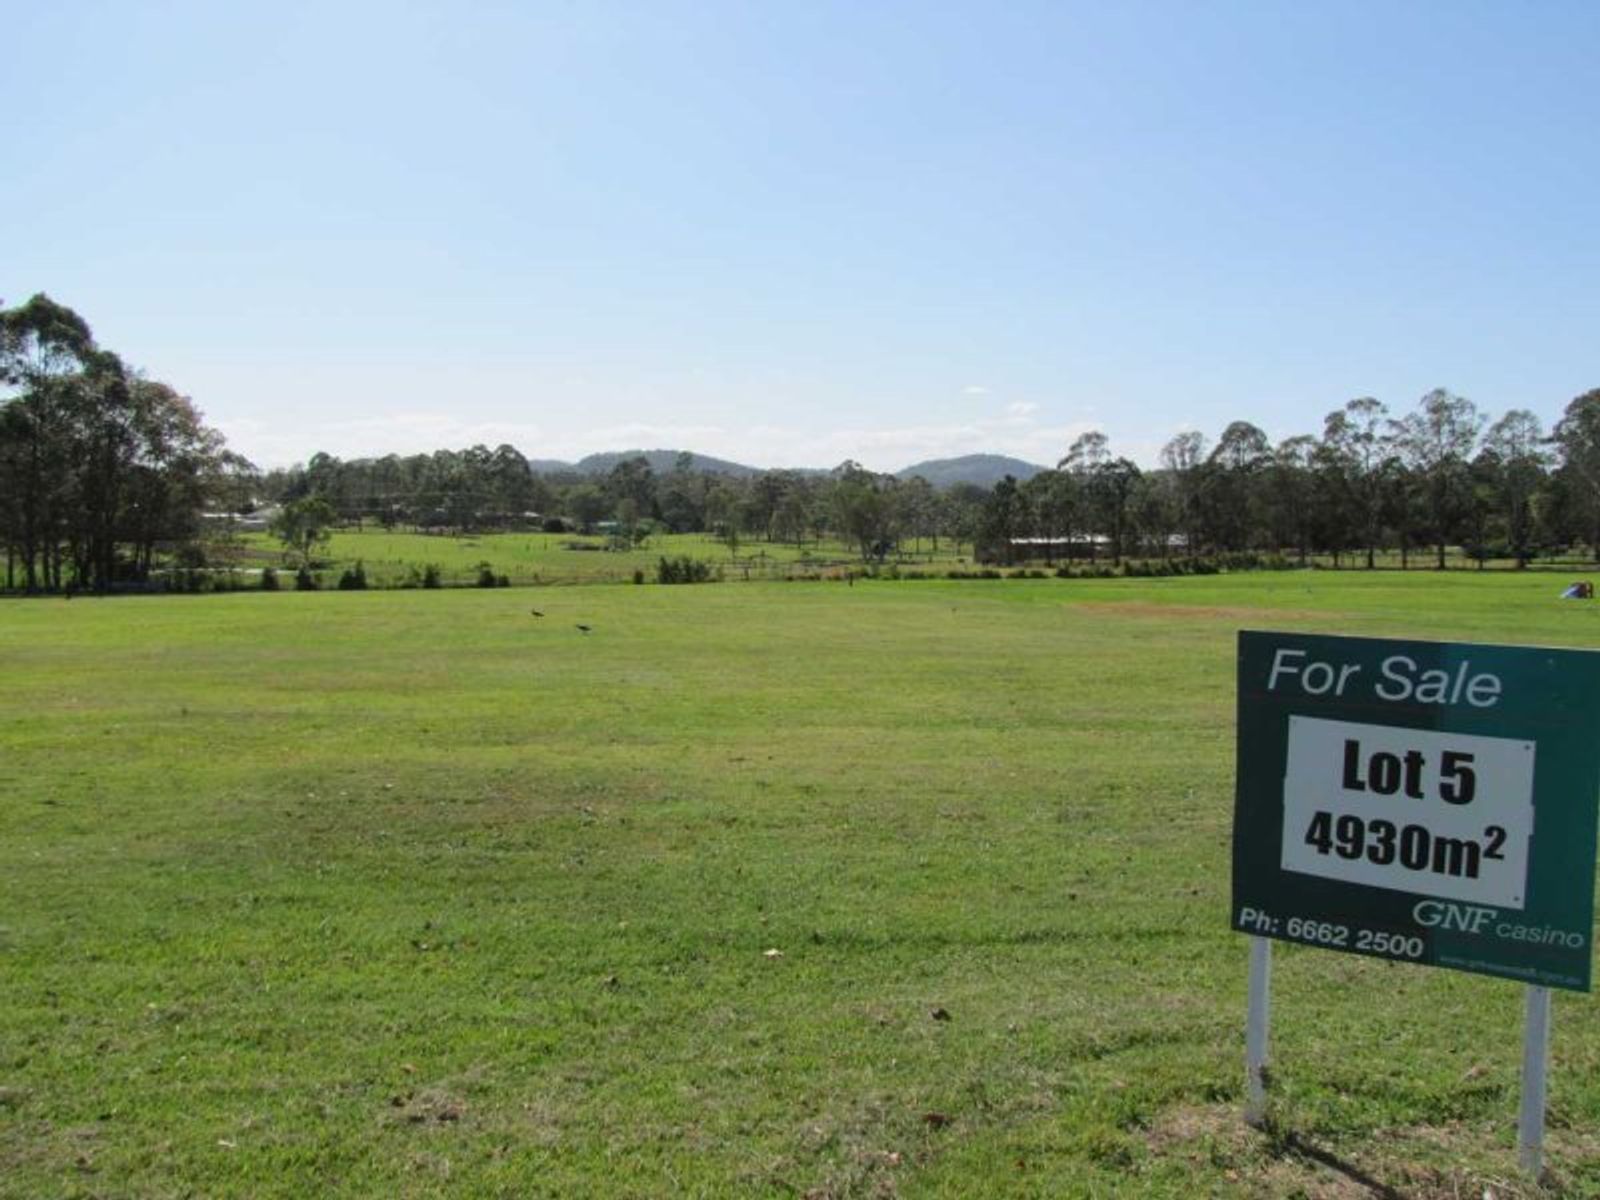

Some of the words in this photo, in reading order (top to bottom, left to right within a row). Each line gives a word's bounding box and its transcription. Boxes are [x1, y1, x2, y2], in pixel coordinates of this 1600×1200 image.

[1268, 649, 1361, 696] For
[1375, 656, 1502, 707] Sale
[1342, 739, 1426, 800] Lot
[1439, 750, 1476, 805] 5
[1238, 906, 1281, 933] Ph:
[1286, 917, 1348, 946] 6662
[1356, 930, 1424, 957] 2500
[1412, 900, 1498, 934] GNF
[1495, 921, 1585, 949] casino
